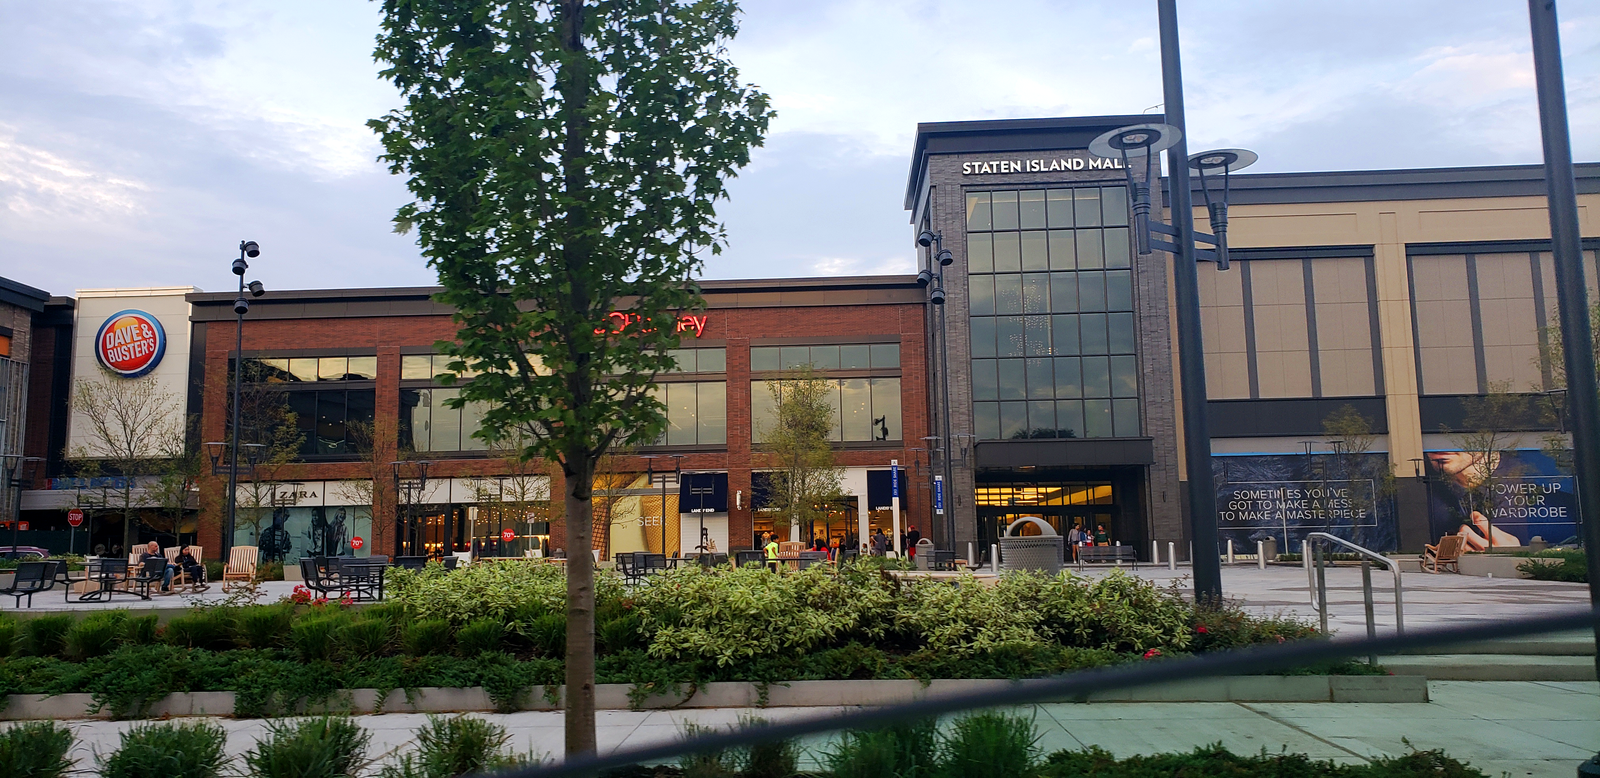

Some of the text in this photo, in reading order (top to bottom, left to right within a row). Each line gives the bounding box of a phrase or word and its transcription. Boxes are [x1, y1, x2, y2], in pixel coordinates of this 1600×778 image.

[962, 160, 1022, 175] STATEN
[1026, 158, 1085, 172] ISLAND
[105, 323, 154, 350] DAVE &
[107, 338, 155, 363] BUSTER'S
[279, 487, 319, 499] ZARA
[1304, 487, 1348, 499] YOU'VE
[1541, 482, 1562, 494] UP
[1228, 500, 1253, 510] GOT
[1256, 500, 1272, 510] TO
[1276, 499, 1309, 510] MAKE
[1312, 499, 1320, 509] A
[1504, 495, 1546, 506] YOUR
[69, 513, 83, 522] STOP
[1219, 511, 1235, 521] TO
[1239, 510, 1271, 520] MAKE
[1275, 510, 1284, 520] A
[1485, 506, 1568, 519] WARDROBE
